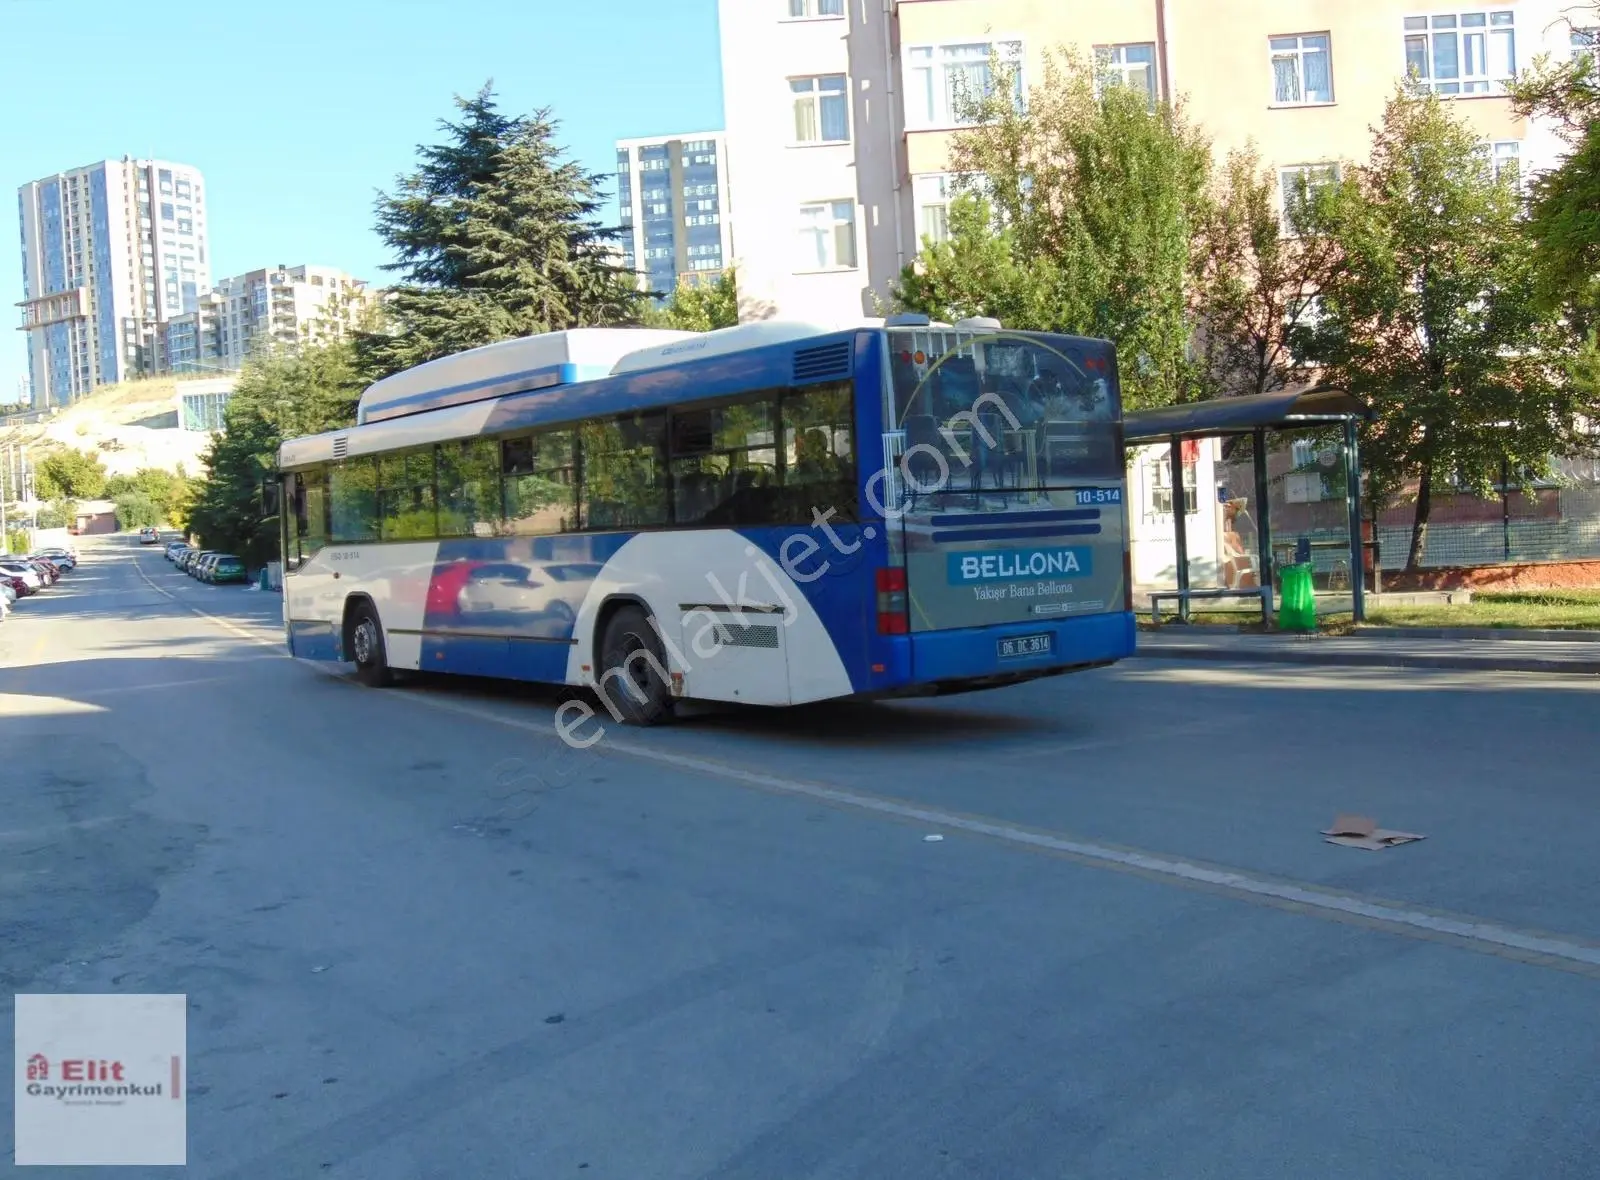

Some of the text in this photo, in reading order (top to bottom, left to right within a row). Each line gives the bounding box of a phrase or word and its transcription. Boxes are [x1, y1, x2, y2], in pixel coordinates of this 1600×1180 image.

[1075, 490, 1120, 503] 10-514
[961, 551, 1080, 579] BELLONA
[1010, 584, 1034, 597] Bana
[1037, 581, 1073, 595] Bellona
